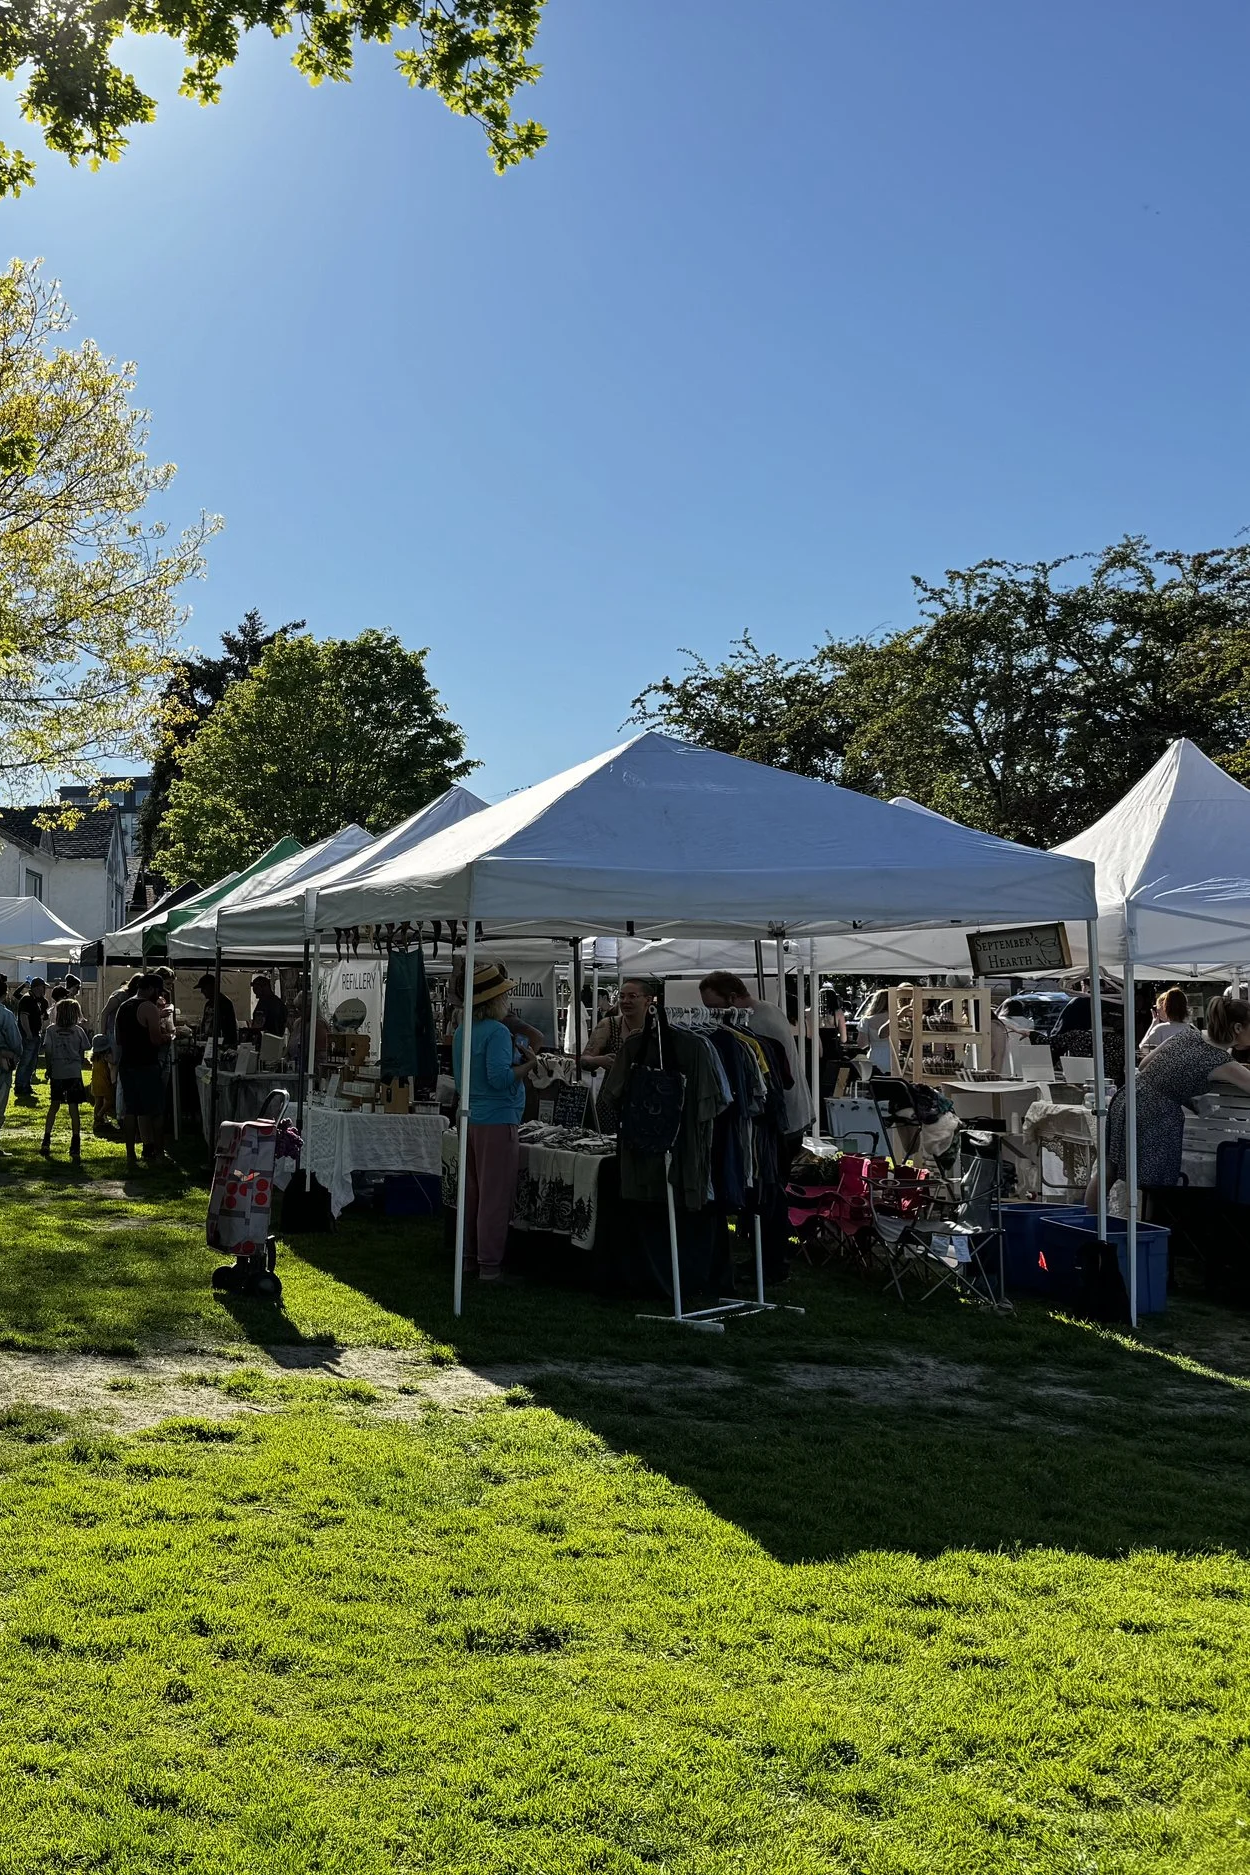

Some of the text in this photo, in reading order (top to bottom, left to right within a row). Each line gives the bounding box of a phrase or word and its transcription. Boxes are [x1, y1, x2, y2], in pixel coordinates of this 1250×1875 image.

[975, 931, 1040, 952] SEPTEMBER'S
[988, 955, 1033, 969] HEARTH
[342, 972, 376, 990] REFILLERY
